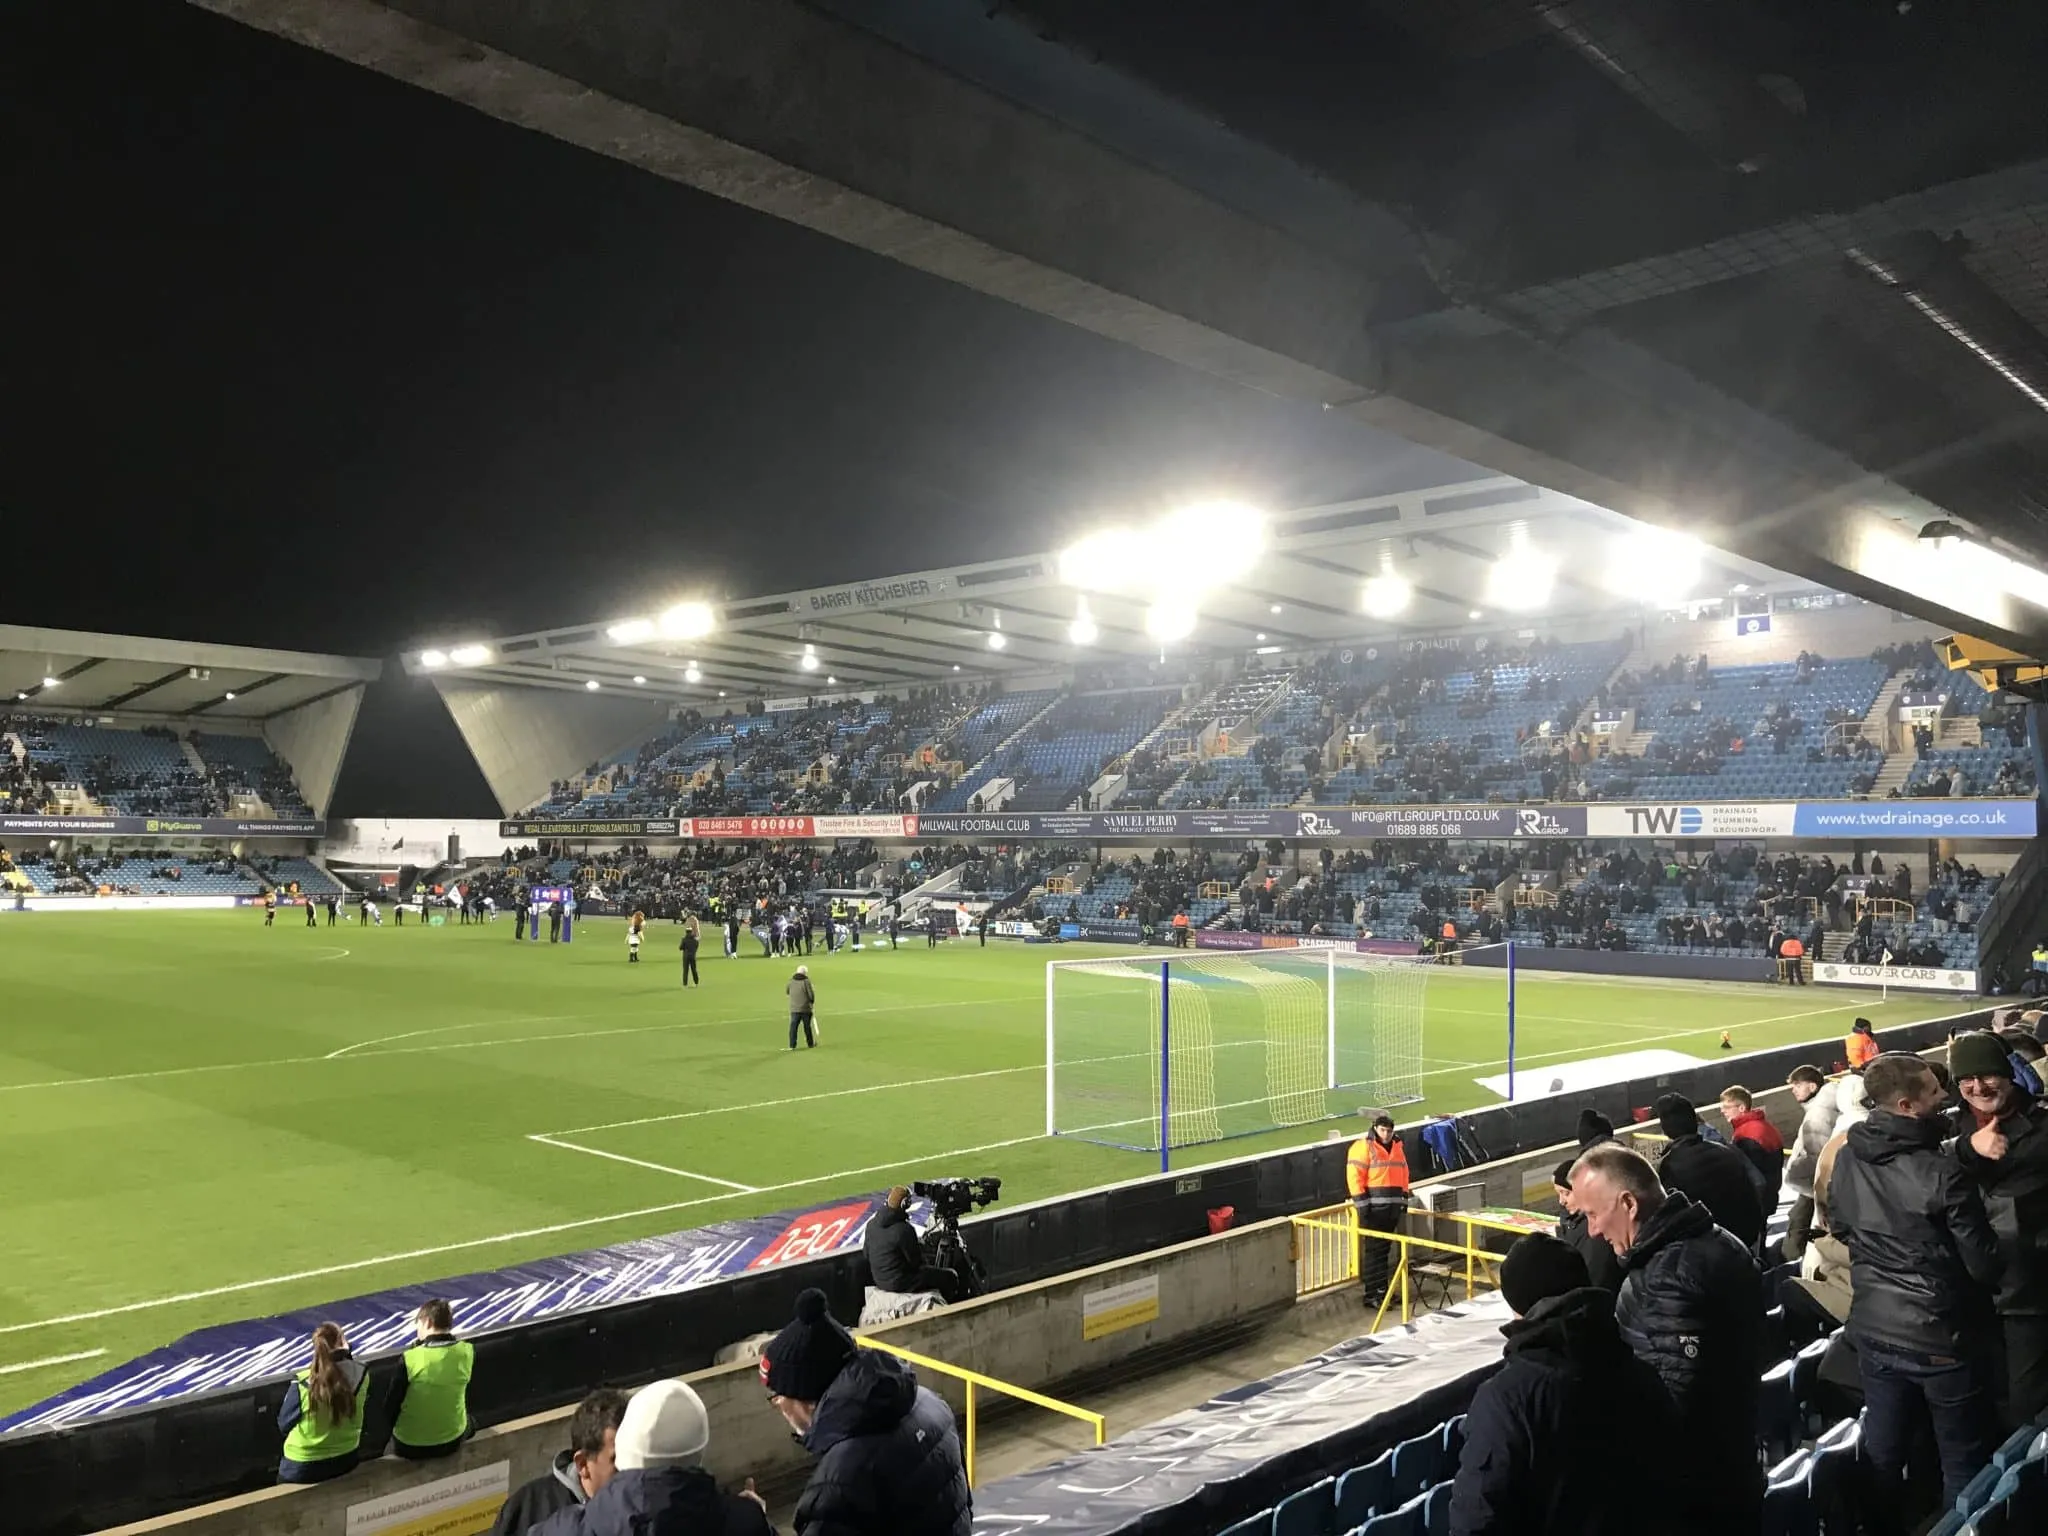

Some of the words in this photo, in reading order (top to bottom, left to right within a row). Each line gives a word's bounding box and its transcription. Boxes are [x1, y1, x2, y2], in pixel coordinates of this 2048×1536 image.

[810, 591, 852, 610] BARRY
[855, 579, 930, 605] KITCHENER
[1103, 815, 1143, 827] SAMUEL
[1145, 815, 1177, 827] PERRY
[1352, 809, 1500, 822] INFO@RTLGROUPLTD.CO.UK
[1713, 816, 1758, 824] PLUMBING
[1817, 810, 2006, 830] www.twdrainage.co.uk
[4, 820, 43, 828] PAYMENTS
[60, 821, 80, 829] YOUR
[541, 824, 571, 833] ELEVATORS
[577, 823, 589, 833] LIFT
[589, 823, 629, 833] CONSULTANTS
[630, 823, 641, 833] LTD
[920, 816, 959, 831] MILLWALL
[961, 816, 1004, 831] FOOTBALL
[1007, 816, 1030, 831] CLUB
[1901, 967, 1936, 981] CARS
